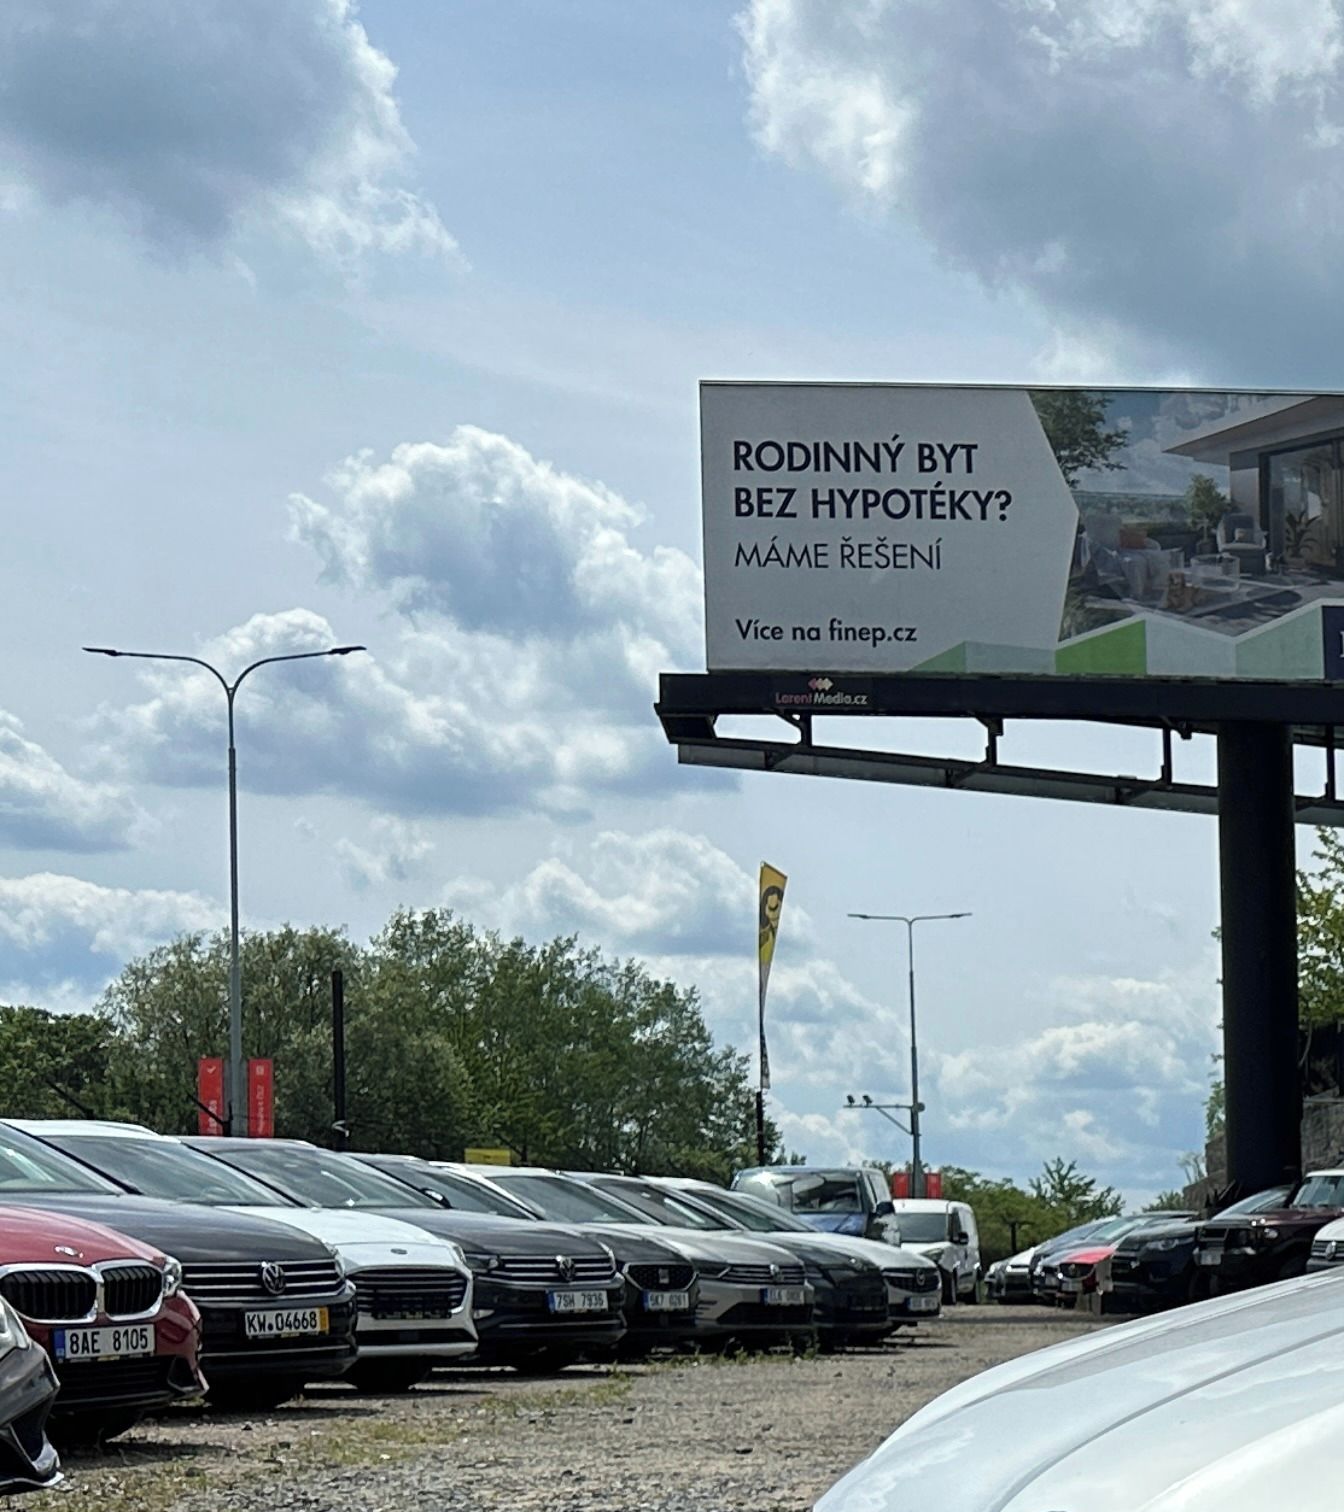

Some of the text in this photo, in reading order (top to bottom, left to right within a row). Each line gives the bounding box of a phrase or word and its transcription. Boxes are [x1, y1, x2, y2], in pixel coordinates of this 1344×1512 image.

[733, 433, 978, 474] RODINNÝ BYT
[734, 481, 1012, 522] BEZ HYPOTÉKY?
[734, 535, 942, 570] MÁME ŘEŠENÍ
[736, 617, 918, 647] Více na finep.cz
[69, 1327, 148, 1353] 8AE 8105
